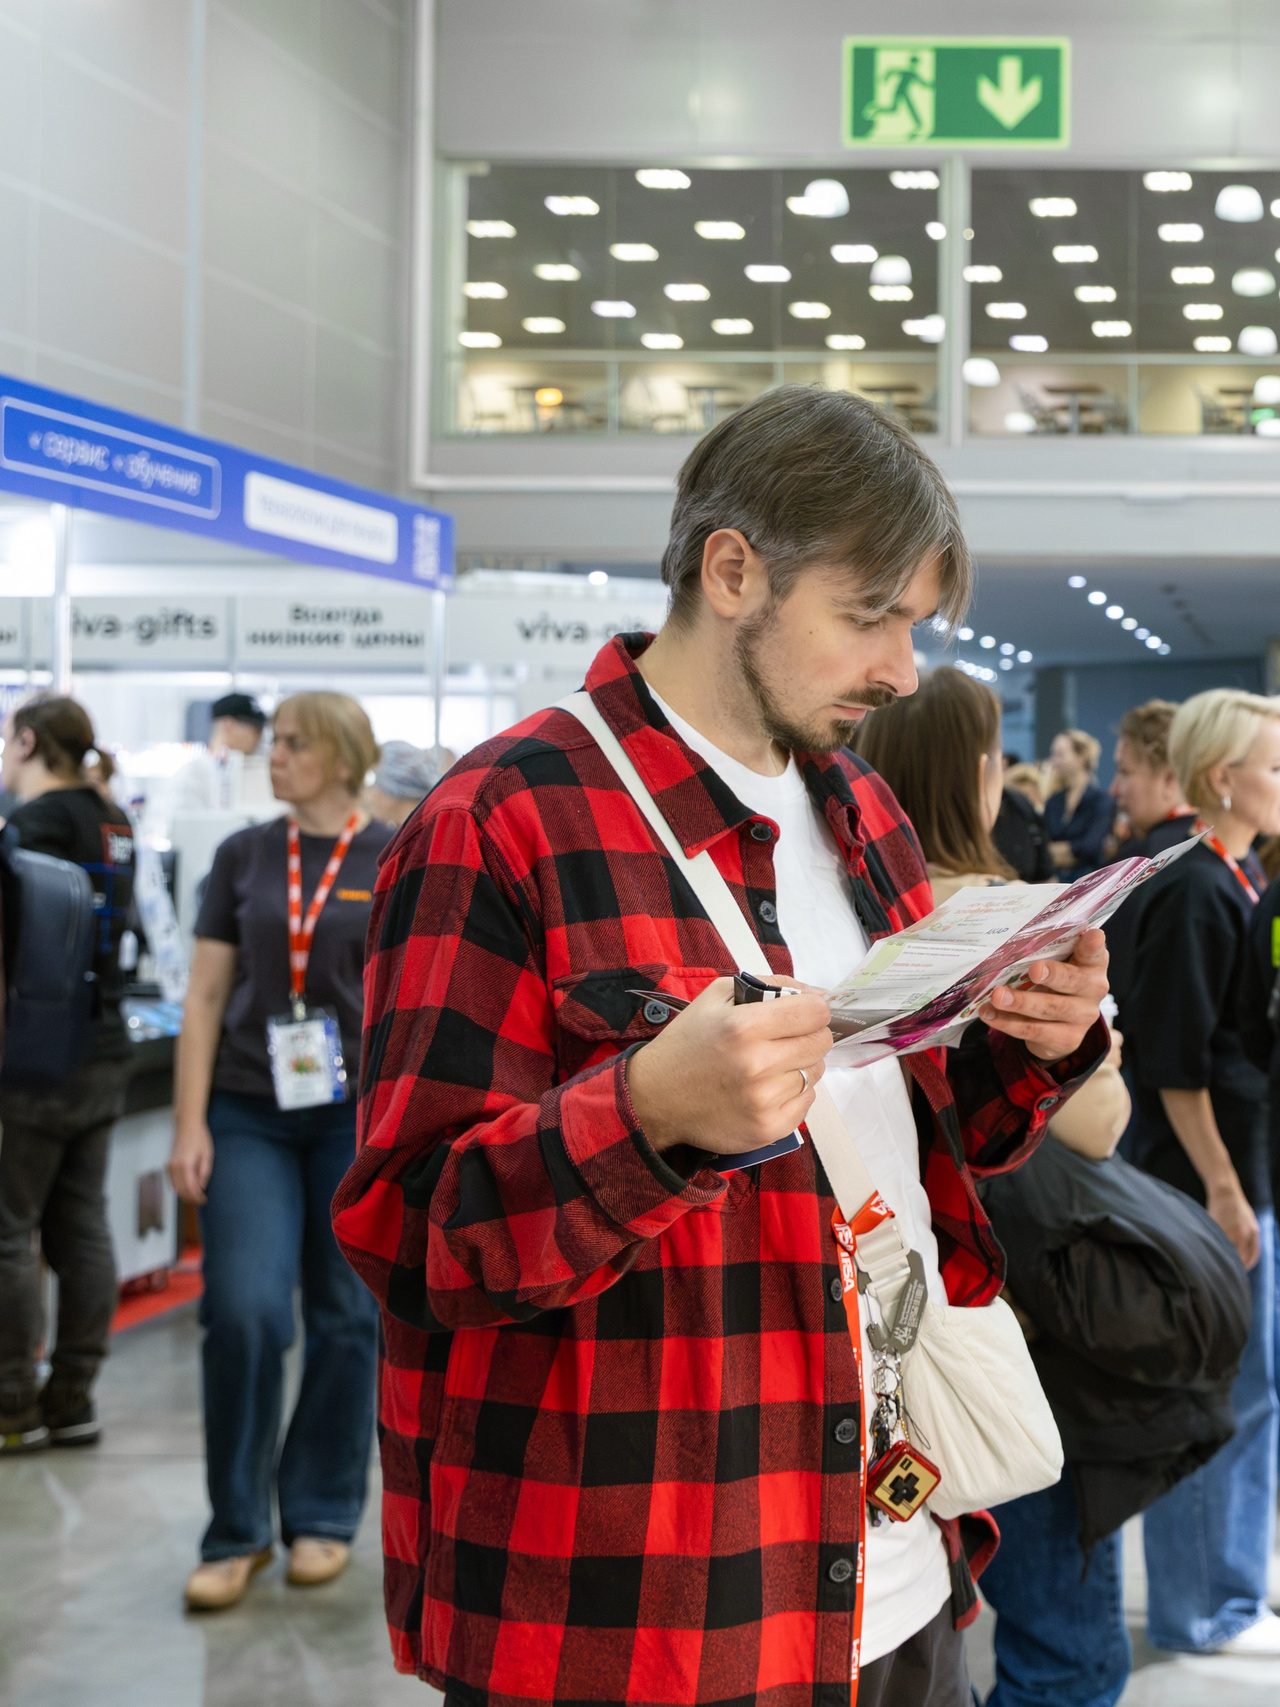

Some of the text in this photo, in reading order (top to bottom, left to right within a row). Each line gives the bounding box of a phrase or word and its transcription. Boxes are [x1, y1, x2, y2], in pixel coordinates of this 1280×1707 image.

[60, 607, 217, 646] iva-gifts
[288, 604, 383, 626] Всегда
[247, 630, 425, 649] низкие цены
[840, 1252, 856, 1294] IPSA
